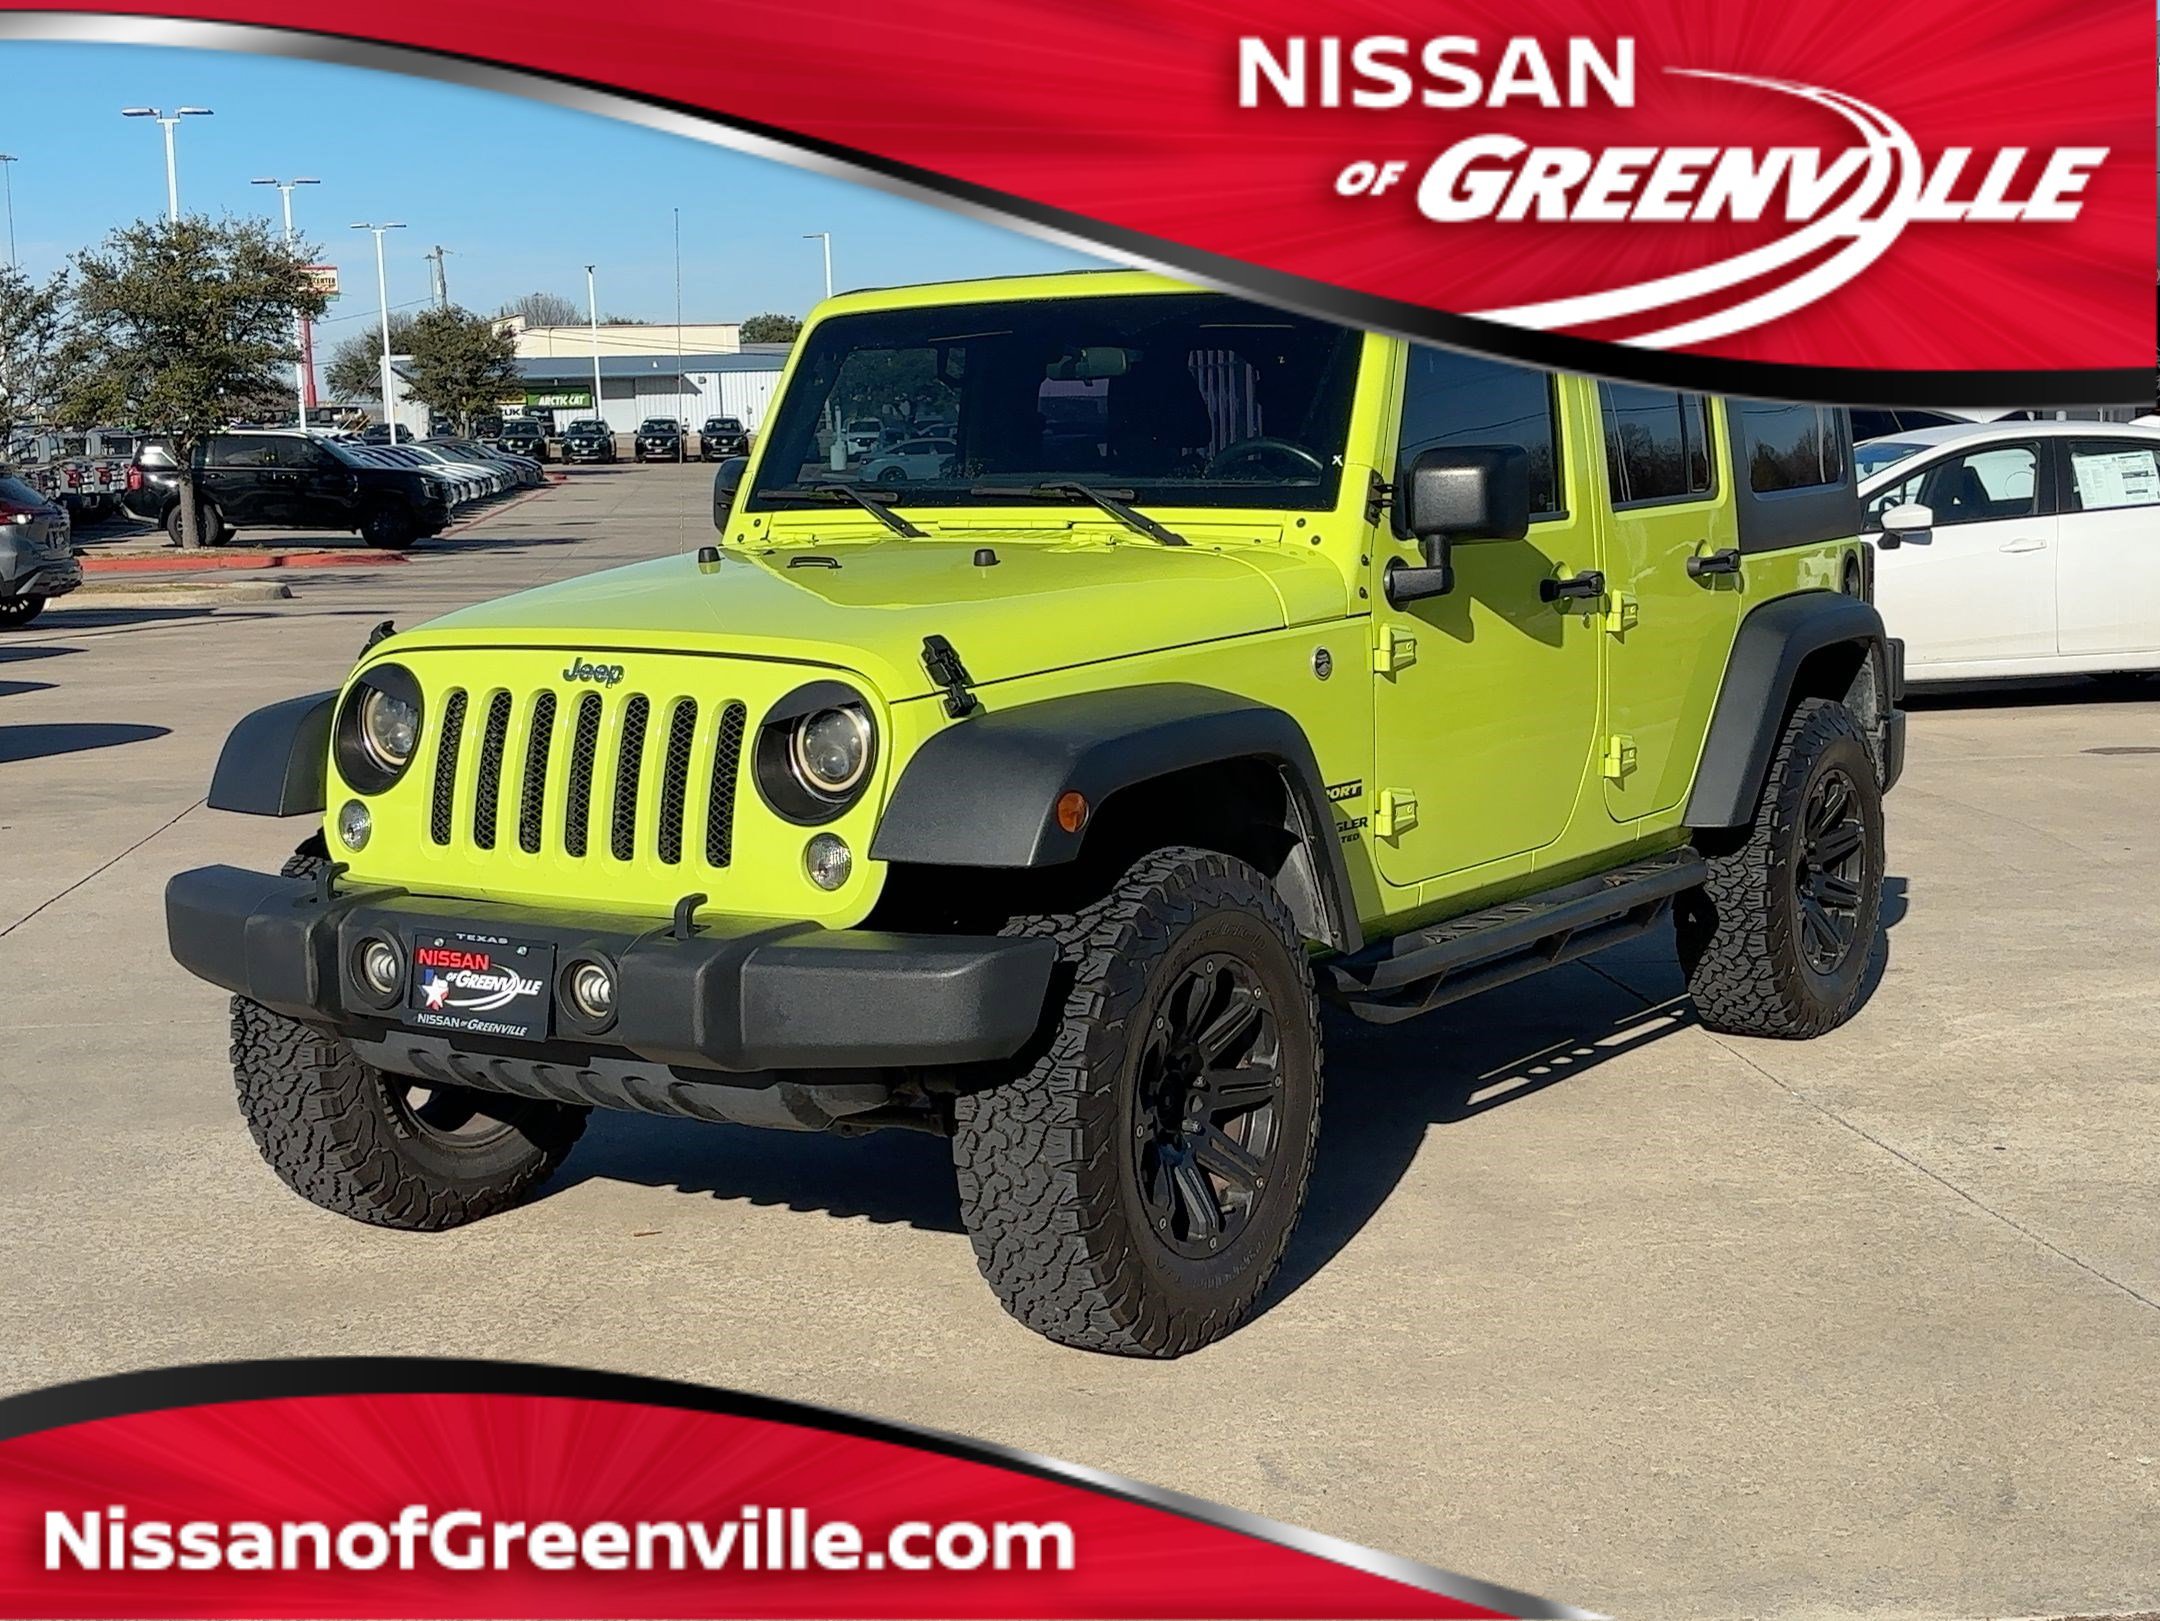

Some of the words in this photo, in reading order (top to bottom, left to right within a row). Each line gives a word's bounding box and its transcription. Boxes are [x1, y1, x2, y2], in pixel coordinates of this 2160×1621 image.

[539, 395, 568, 406] ARCTIC
[568, 394, 585, 405] CAT
[563, 657, 624, 689] Jeep
[456, 933, 508, 944] TEXAS
[418, 949, 490, 971] NISSAN
[456, 970, 543, 996] GREENVILLE
[417, 1013, 459, 1028] NISSAN
[467, 1019, 527, 1037] GREENVILLE
